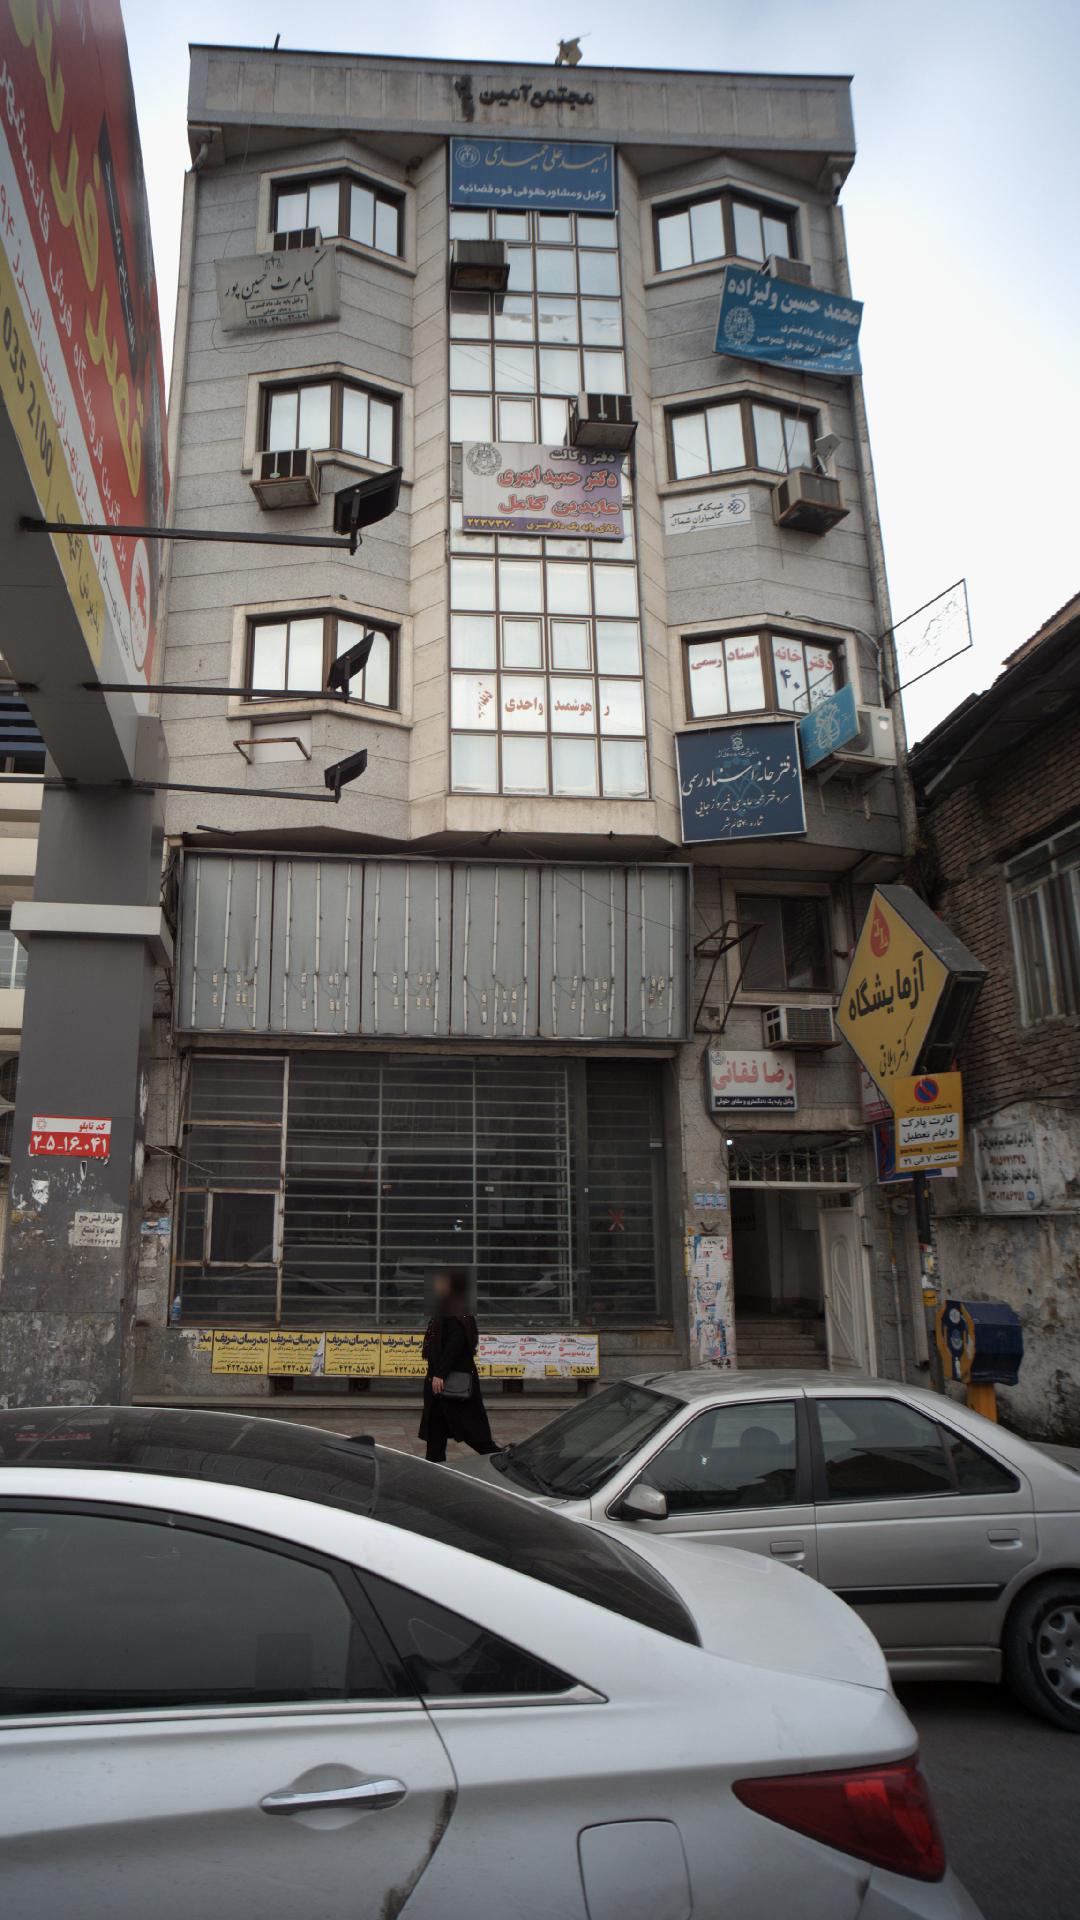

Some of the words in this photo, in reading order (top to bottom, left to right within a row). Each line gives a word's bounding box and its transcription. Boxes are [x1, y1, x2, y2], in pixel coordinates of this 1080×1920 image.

[530, 86, 594, 110] مجتمع
[494, 185, 513, 197] قوه
[513, 186, 548, 199] حقوقی
[548, 188, 576, 199] مشاور
[780, 293, 821, 314] حسین
[824, 303, 860, 326] محمد
[780, 325, 814, 337] دادگستری
[756, 335, 785, 346] خصوصی
[4, 306, 27, 395] 035
[28, 380, 53, 478] 2100
[73, 341, 104, 465] فروشگاه
[551, 449, 588, 464] وکالت
[590, 450, 615, 464] دفتر
[543, 469, 581, 489] حمید
[584, 470, 618, 491] دکتر
[498, 494, 548, 514] کامل
[552, 499, 620, 517] عابدین
[526, 520, 567, 532] دادگستری
[727, 645, 761, 661] اسناد
[691, 658, 722, 671] رسمی
[807, 655, 834, 672] دفتر
[505, 697, 544, 716] واحدی
[682, 773, 703, 796] رسمی
[848, 951, 925, 1021] آزمایشگاه
[896, 1018, 914, 1073] دکتر
[763, 1060, 795, 1090] رضا
[95, 1122, 106, 1131] کد
[901, 1117, 928, 1129] پارک
[929, 1114, 955, 1126] کارت
[79, 1122, 94, 1133] تابلو
[903, 1131, 930, 1143] تعطیل
[932, 1128, 948, 1142] ایام
[933, 1152, 958, 1163] ساعت
[215, 1333, 238, 1345] شریف
[237, 1334, 268, 1346] مدرسان
[327, 1335, 349, 1347] شریف
[348, 1335, 380, 1347] مدرسان
